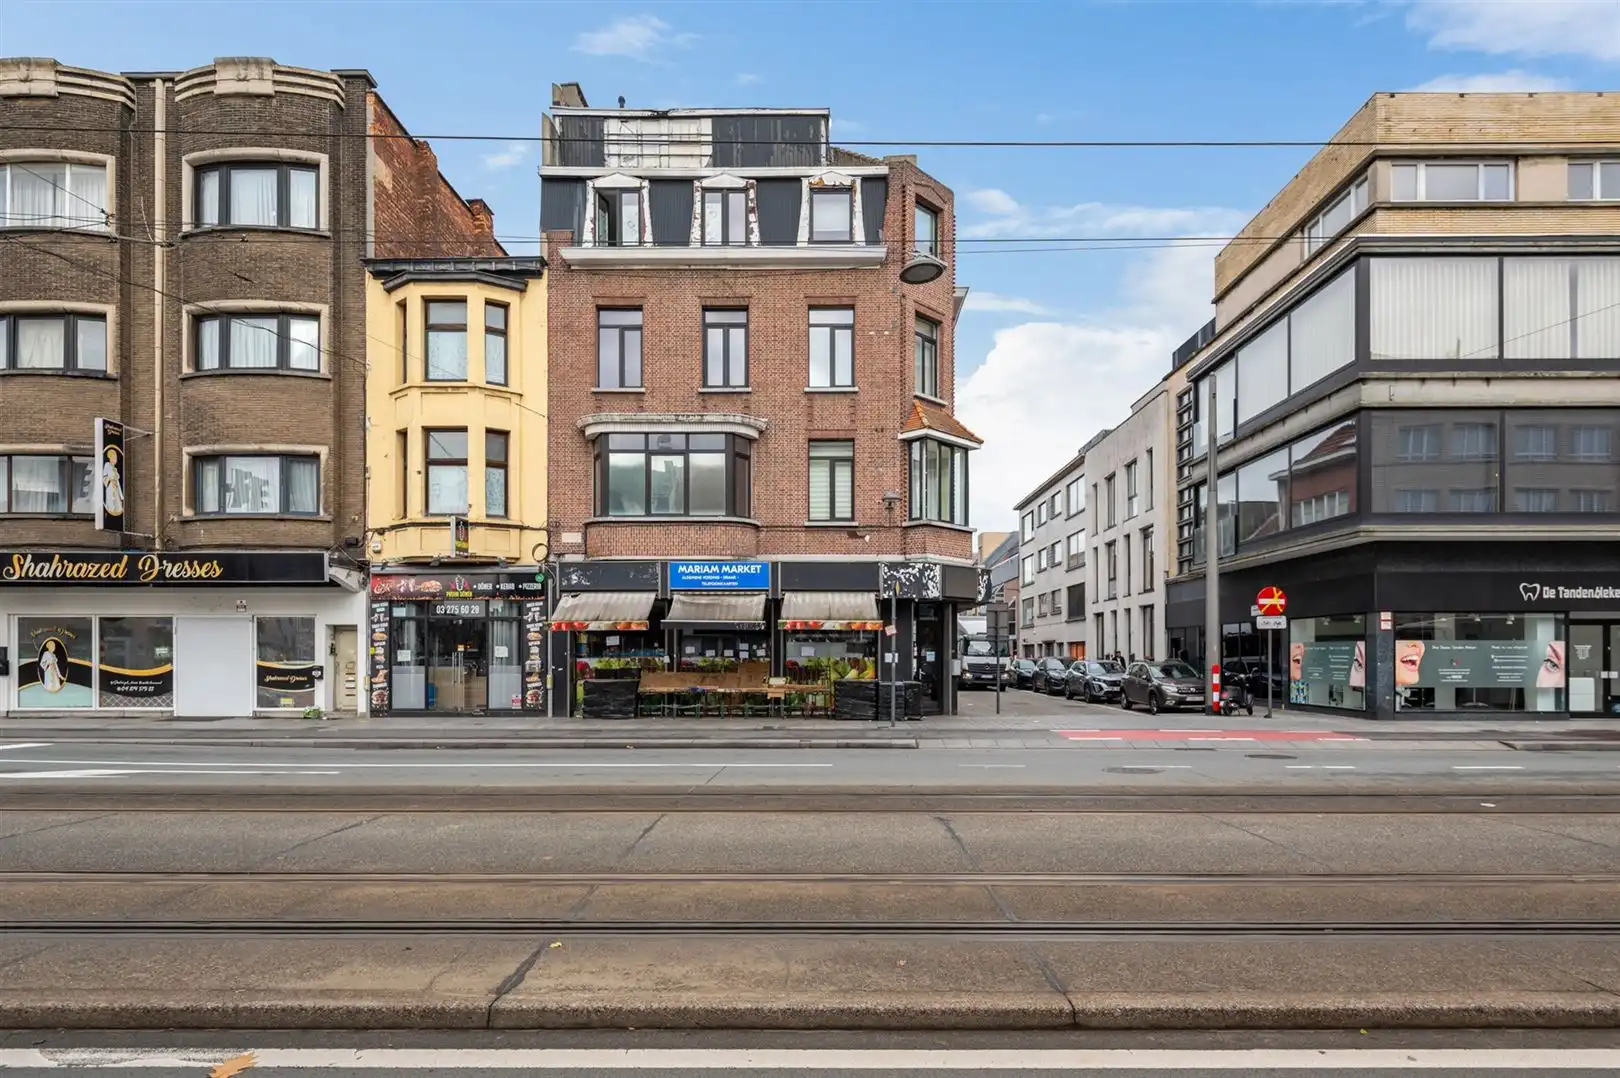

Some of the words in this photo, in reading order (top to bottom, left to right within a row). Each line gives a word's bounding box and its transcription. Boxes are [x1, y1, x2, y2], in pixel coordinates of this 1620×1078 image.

[3, 553, 129, 580] Shahrazed
[138, 553, 224, 582] Dresses
[678, 565, 720, 574] MARIAM
[721, 565, 762, 574] MARKET
[1542, 586, 1556, 599] De
[436, 604, 445, 614] 03
[446, 604, 460, 614] 275
[460, 604, 470, 614] 60
